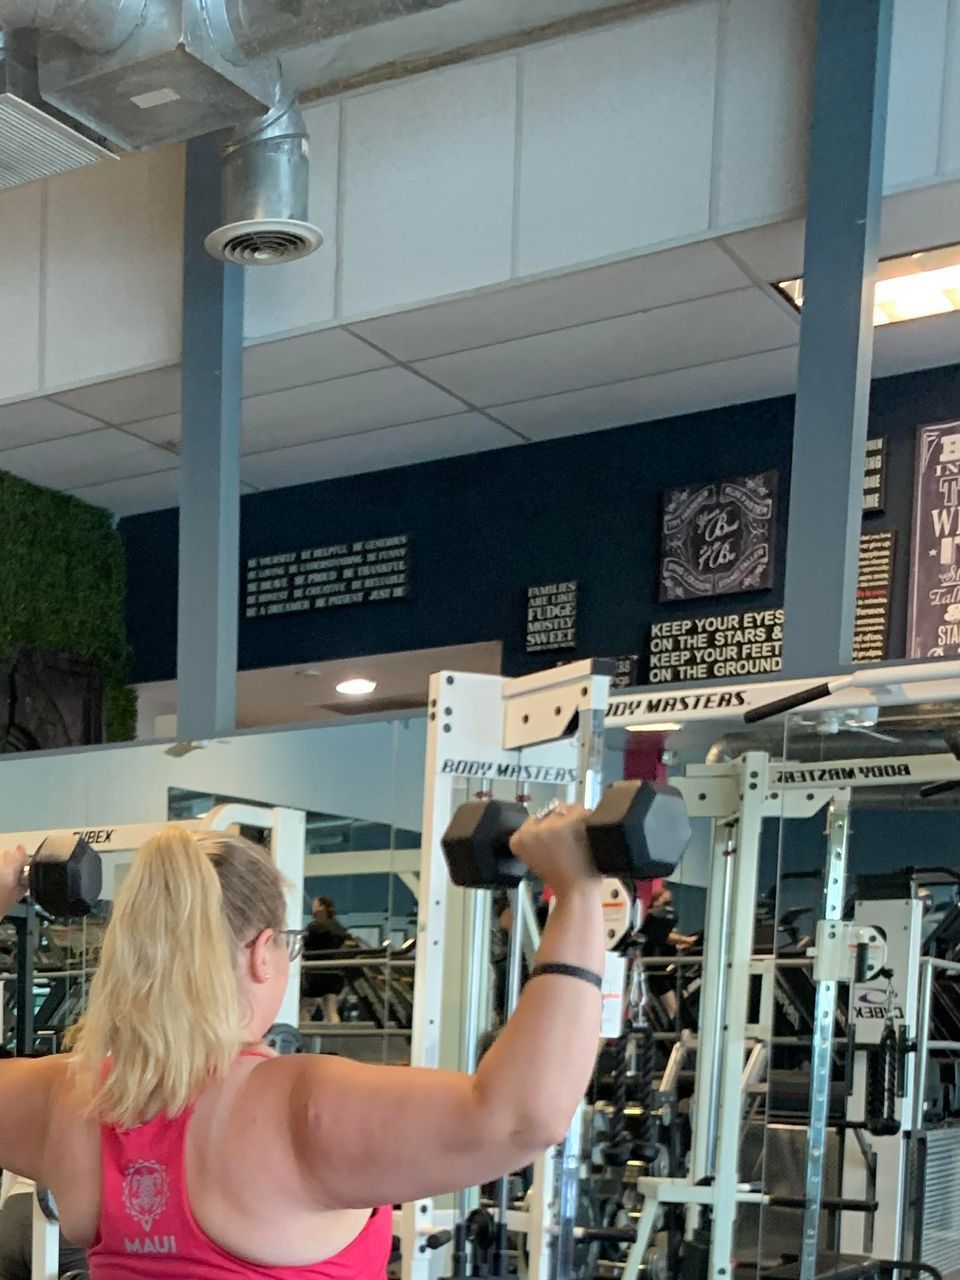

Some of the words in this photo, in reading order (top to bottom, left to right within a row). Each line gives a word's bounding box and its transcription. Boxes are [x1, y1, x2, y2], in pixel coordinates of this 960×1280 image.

[527, 602, 576, 621] FUDGE
[651, 620, 691, 637] KEEP
[695, 615, 739, 633] YOUR
[743, 609, 784, 627] EYES
[526, 629, 575, 646] SWEET
[527, 617, 575, 633] MOSTLY
[650, 638, 673, 652] ON
[678, 634, 708, 649] THE
[714, 628, 766, 646] STARS
[771, 625, 783, 640] &
[650, 650, 691, 667] KEEP
[694, 646, 738, 663] YOUR
[741, 641, 783, 658] FEET
[649, 668, 673, 683] ON
[677, 665, 708, 680] THE
[713, 658, 782, 677] GROUND
[605, 699, 641, 718] ODY
[644, 691, 748, 715] MASTERS
[441, 757, 493, 776] BODY
[496, 763, 578, 782] MASTERS
[124, 1235, 177, 1254] MAUI
